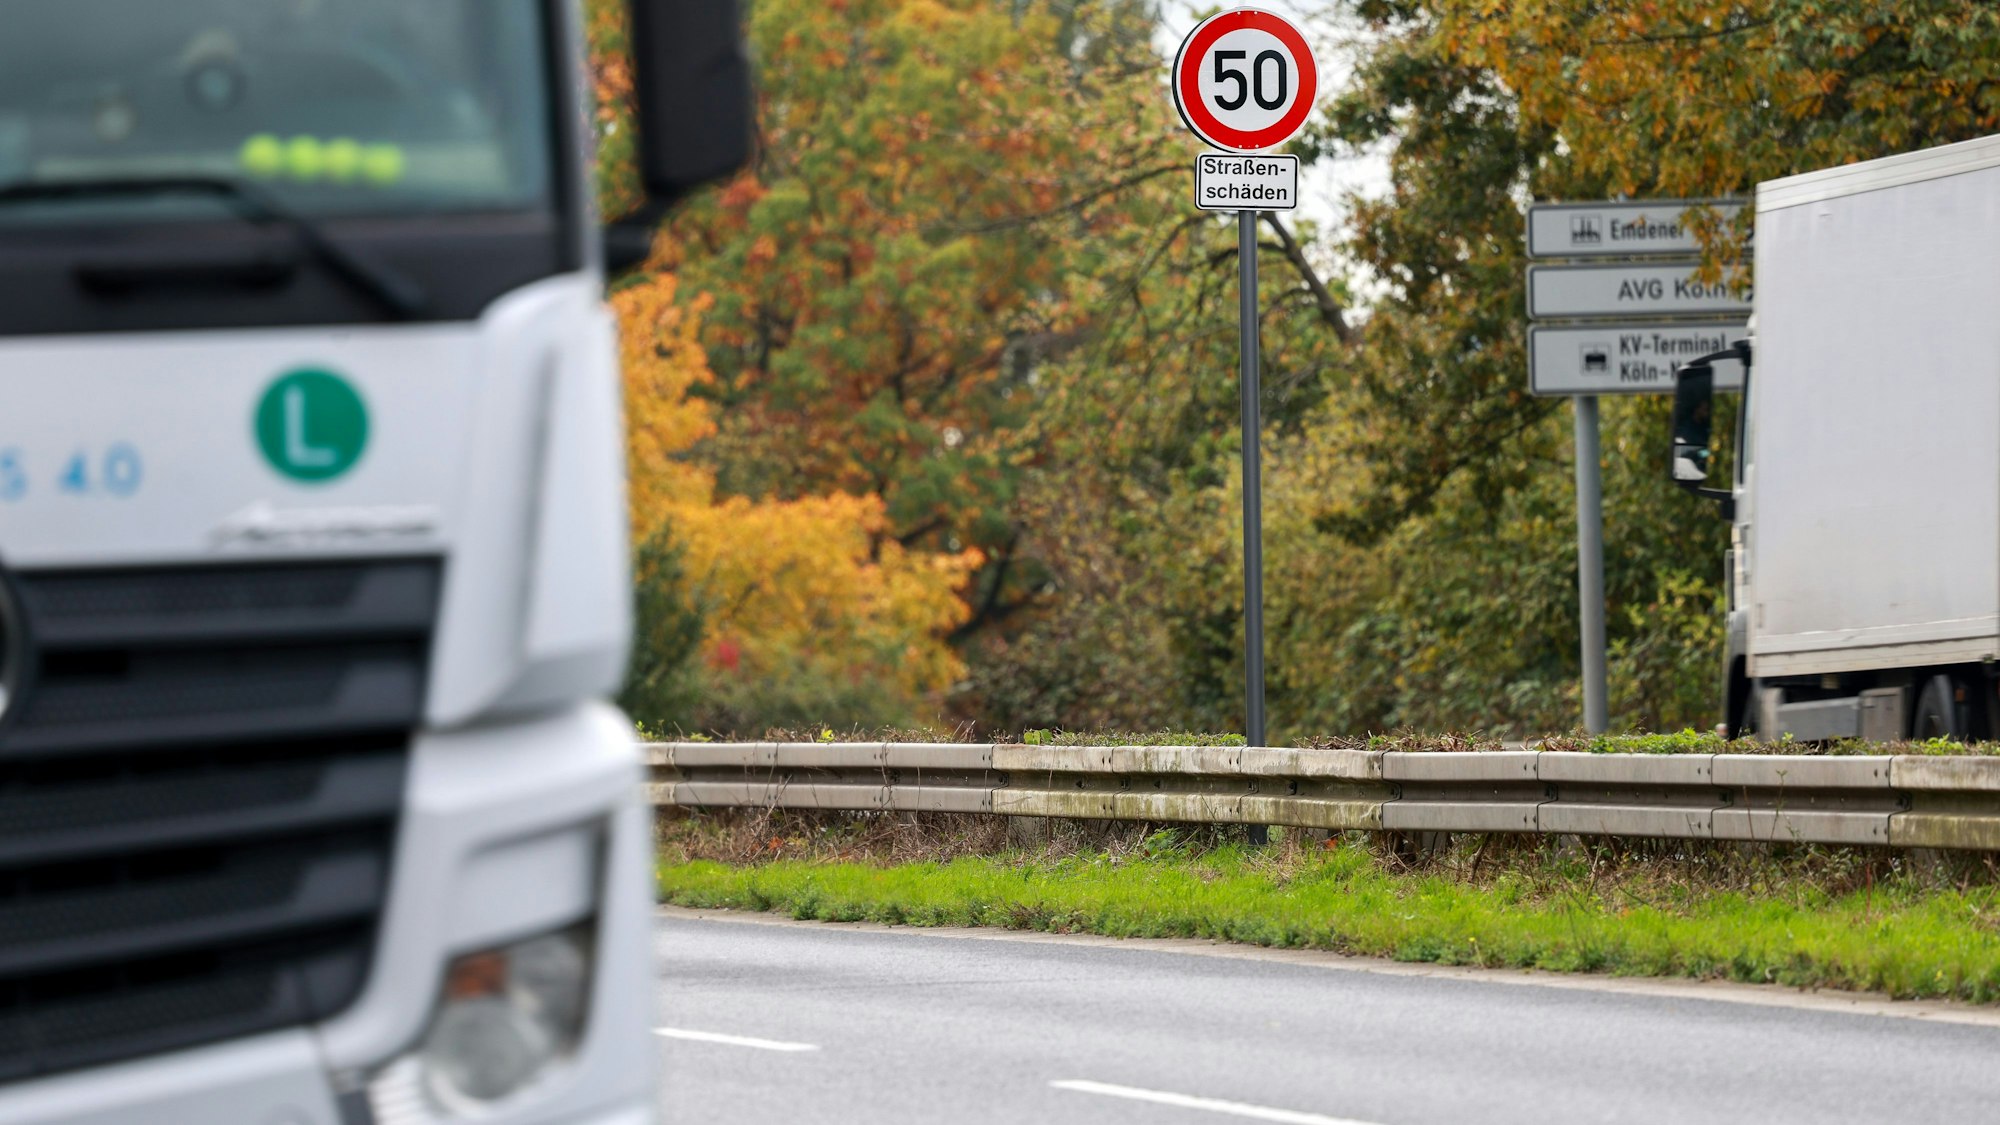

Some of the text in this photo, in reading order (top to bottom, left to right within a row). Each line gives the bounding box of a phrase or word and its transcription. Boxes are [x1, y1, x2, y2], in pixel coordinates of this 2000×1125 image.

[1214, 50, 1287, 111] 50
[1204, 158, 1287, 176] Straßen-
[1206, 183, 1287, 200] schäden
[1618, 279, 1663, 300] AVG
[1620, 333, 1725, 356] KV-Terminal
[1620, 361, 1680, 382] Köln-N
[285, 386, 337, 466] L
